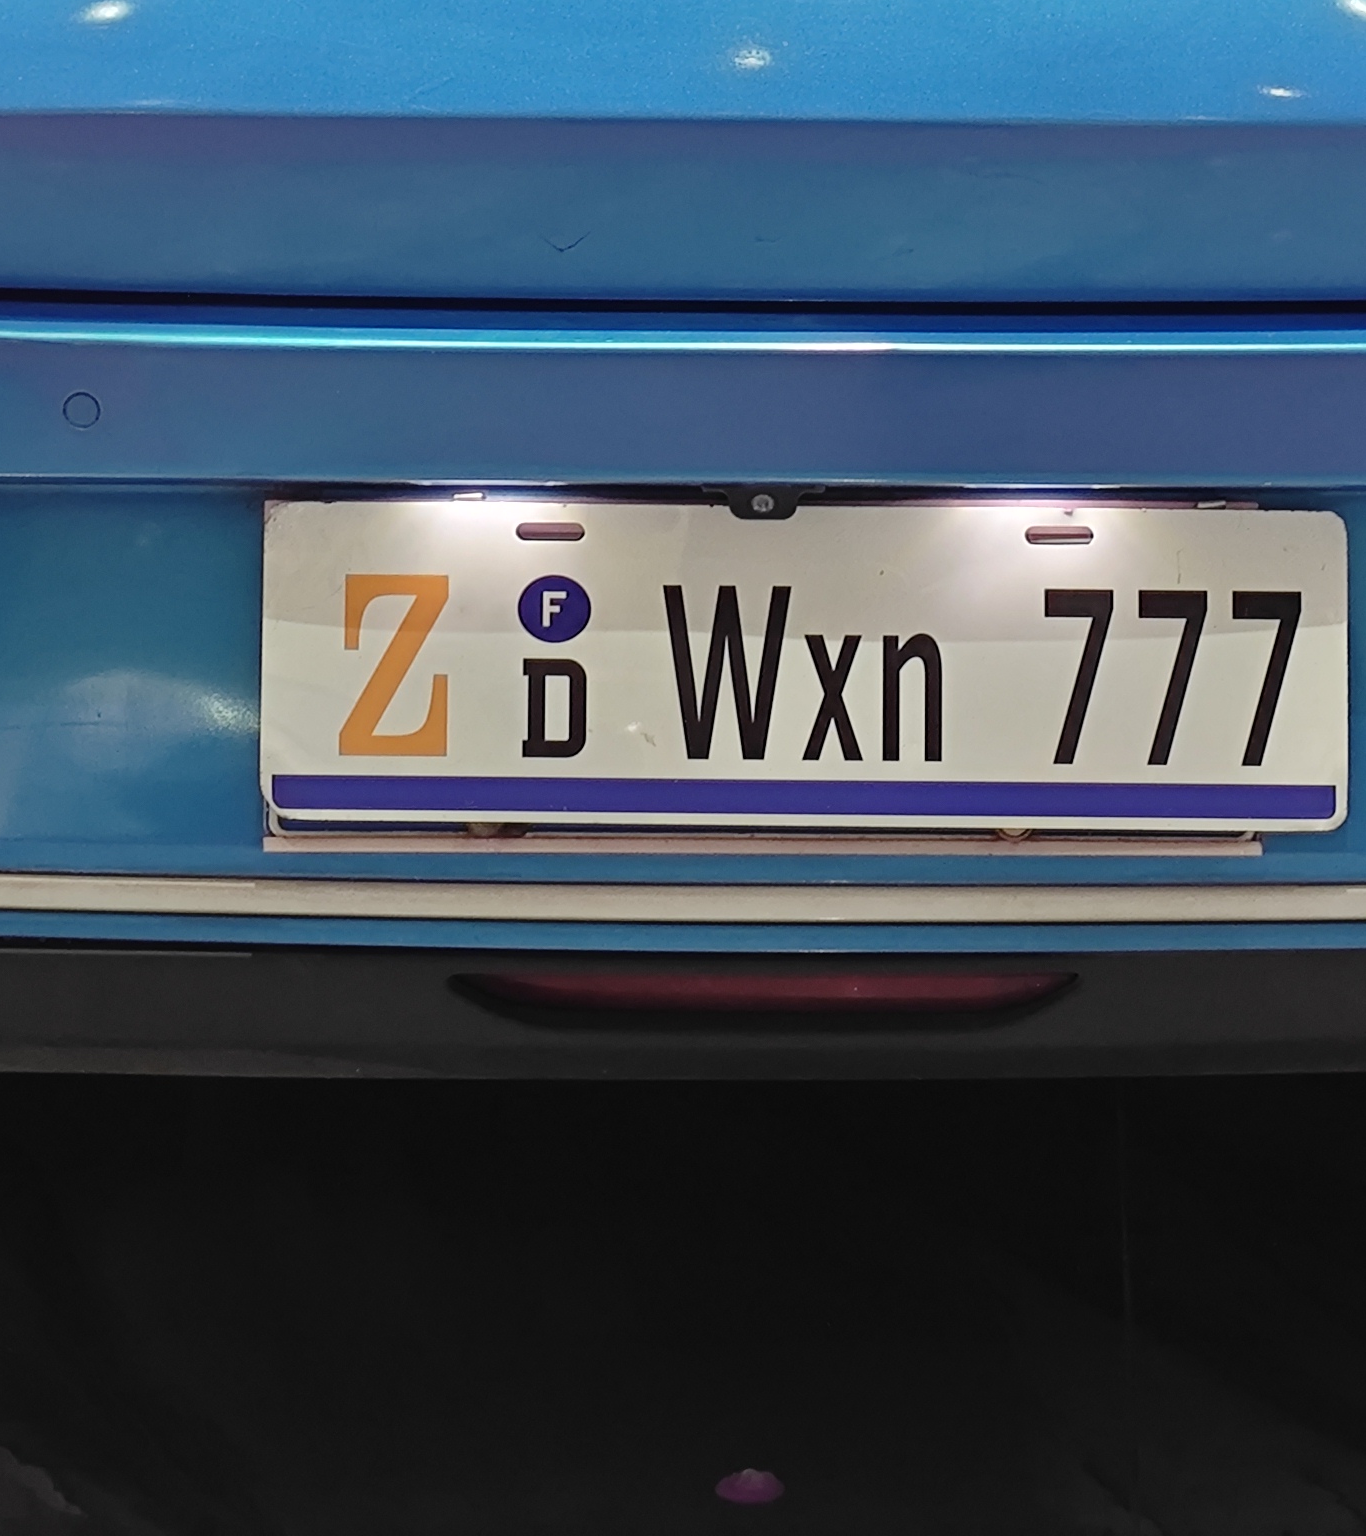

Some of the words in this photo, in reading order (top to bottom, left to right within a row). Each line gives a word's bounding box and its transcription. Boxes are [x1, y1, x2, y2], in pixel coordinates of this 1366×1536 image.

[338, 574, 450, 758] Z
[541, 590, 567, 628] F
[663, 584, 943, 762] Wxn
[1044, 589, 1302, 767] 777
[522, 658, 587, 758] D
